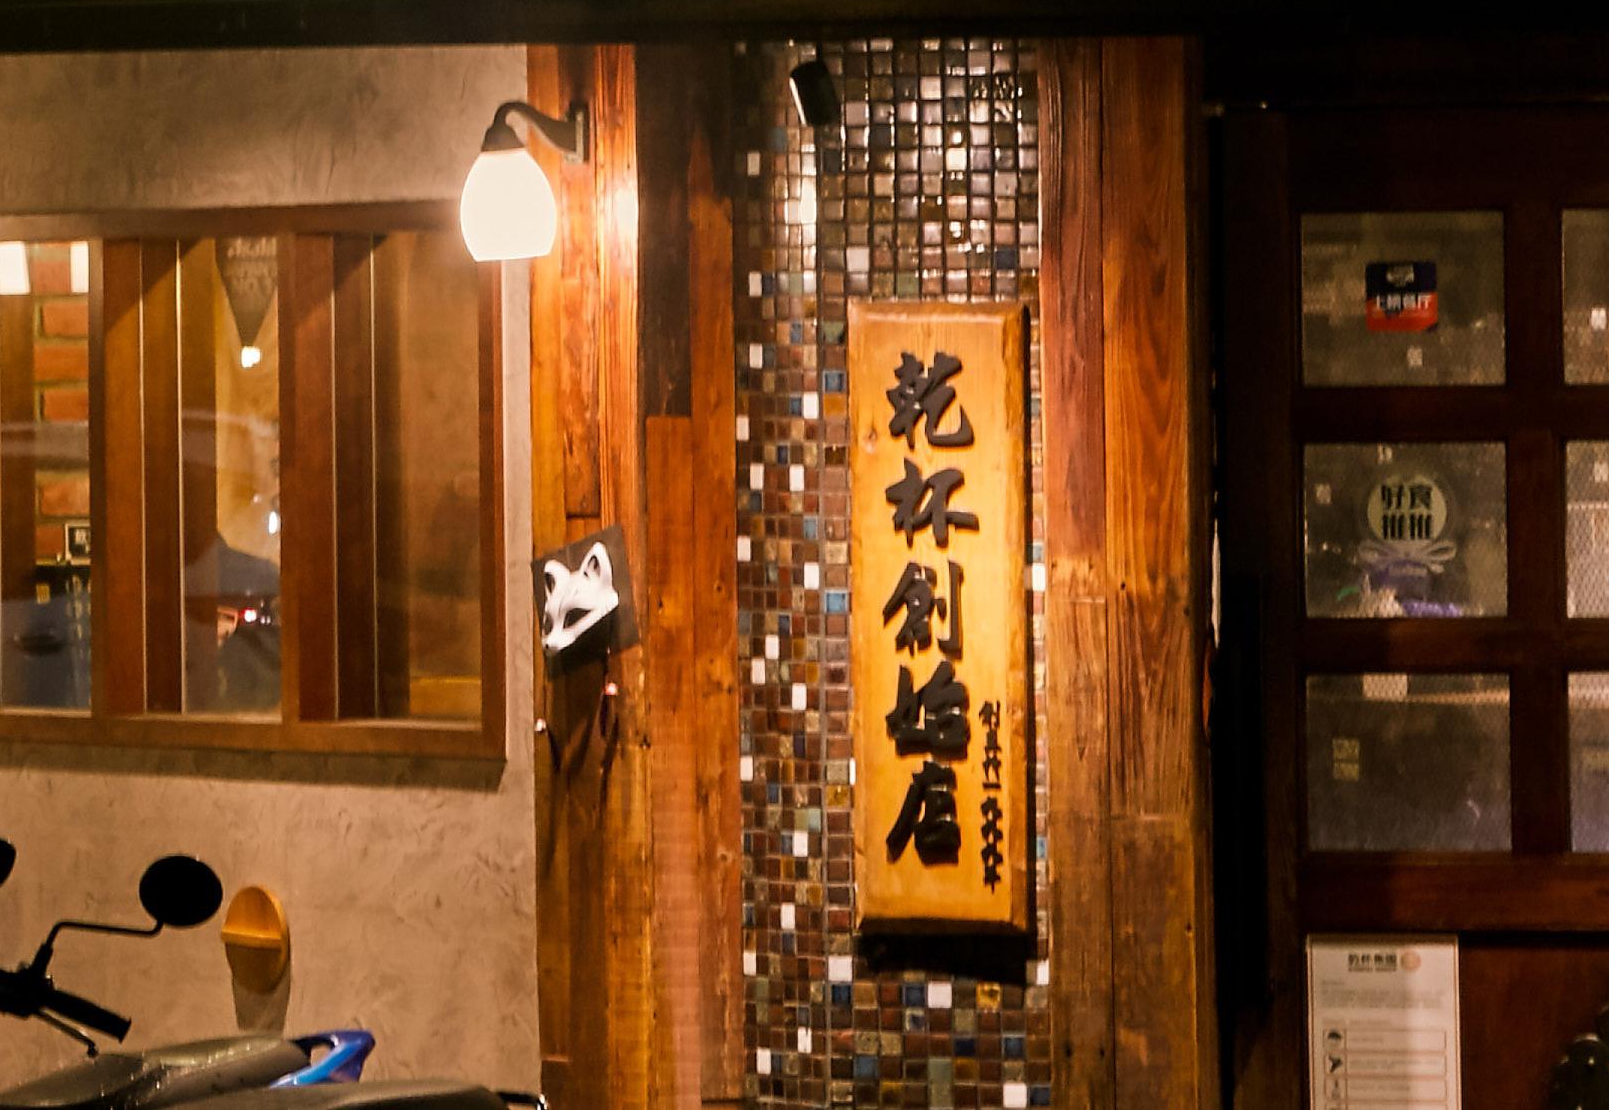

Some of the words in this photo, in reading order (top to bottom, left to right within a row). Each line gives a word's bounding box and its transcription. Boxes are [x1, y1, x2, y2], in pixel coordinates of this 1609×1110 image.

[882, 351, 980, 866] 乾杯創始店
